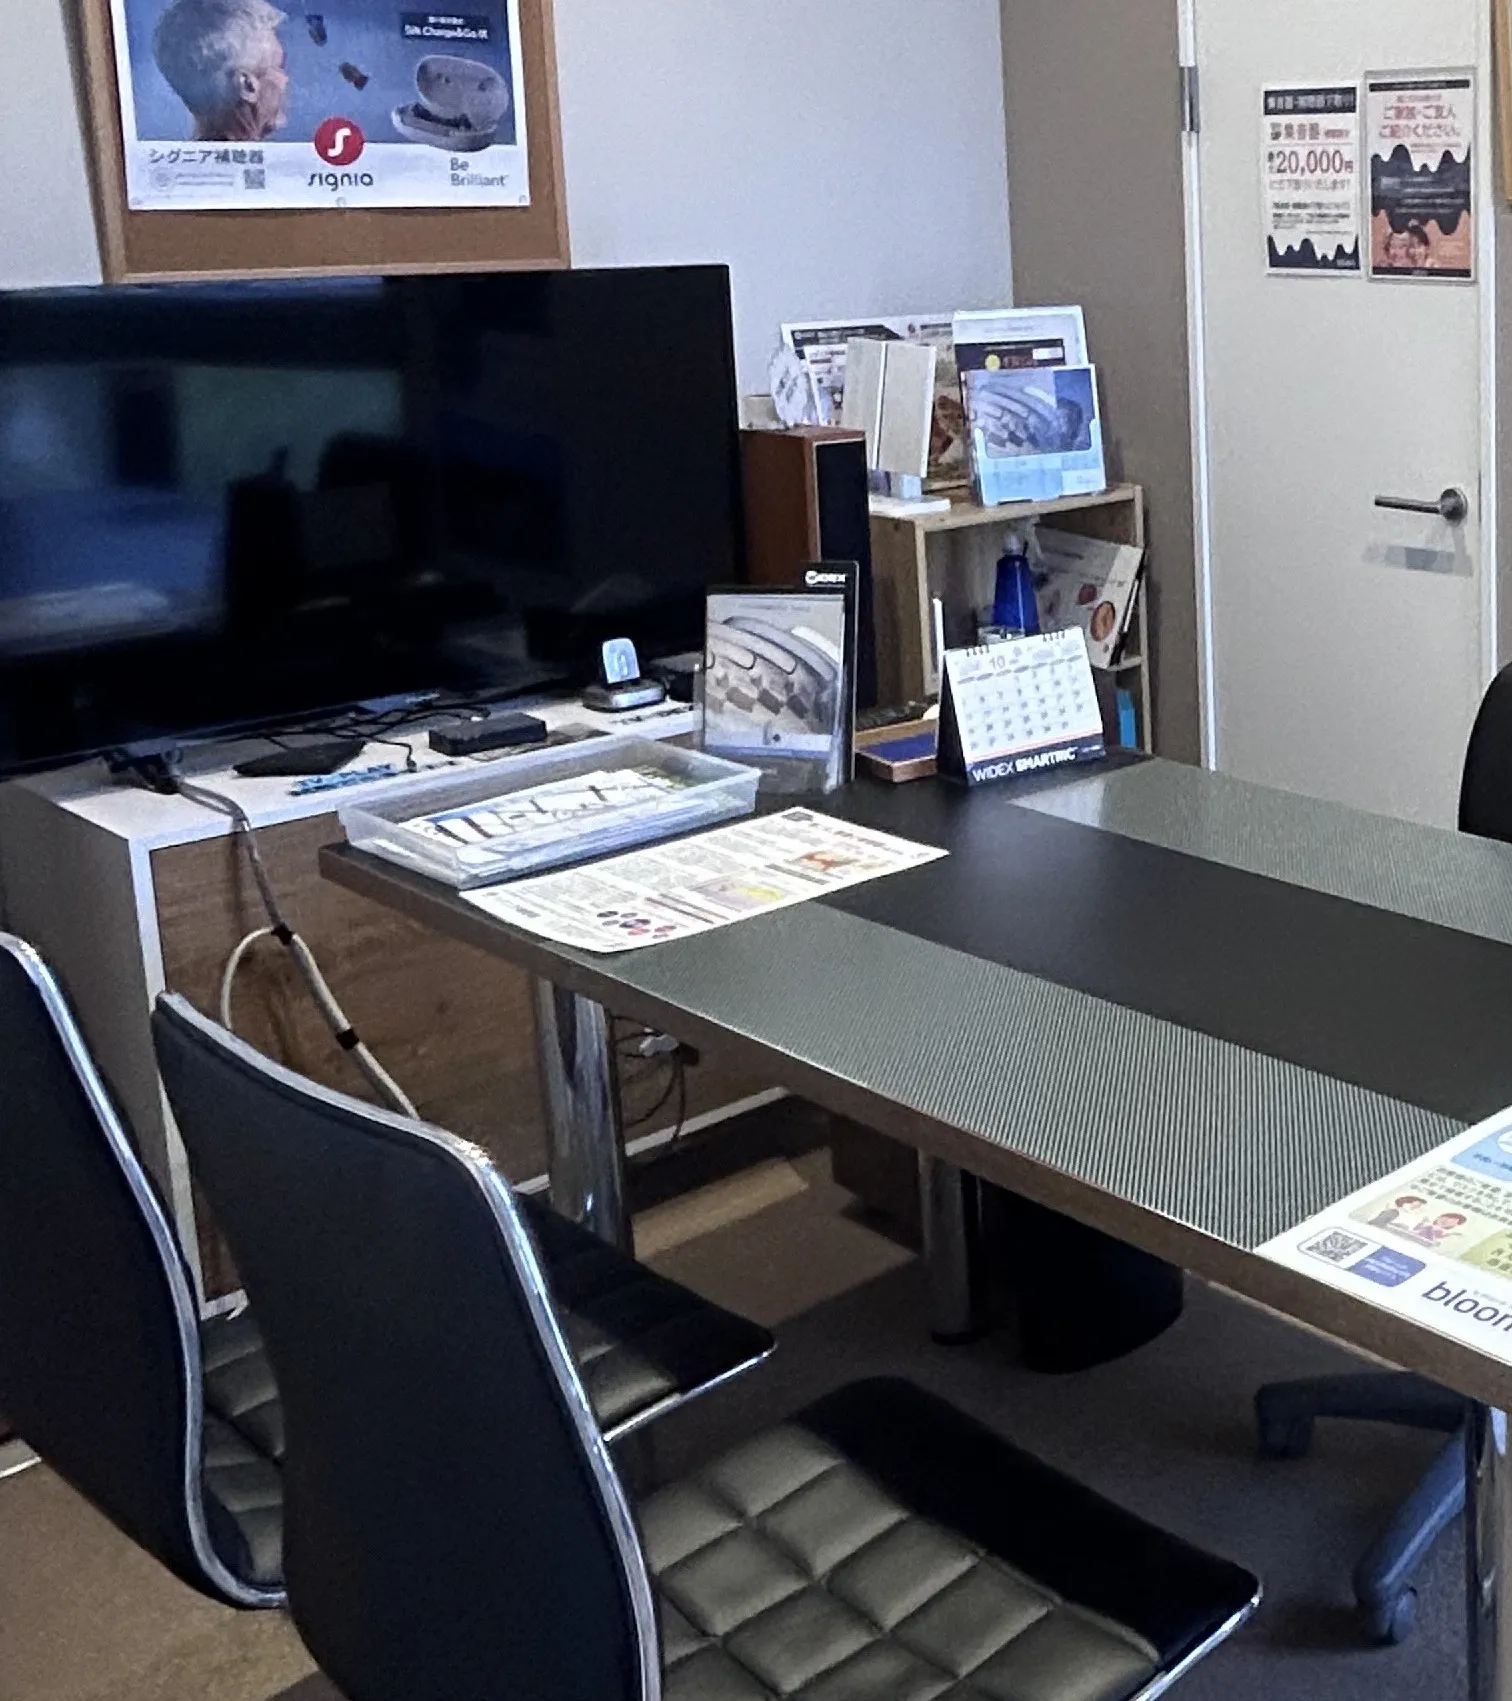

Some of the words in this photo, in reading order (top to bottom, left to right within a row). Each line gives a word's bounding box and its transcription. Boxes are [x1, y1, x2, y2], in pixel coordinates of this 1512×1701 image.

[149, 148, 264, 164] シグニア補聴器
[450, 157, 470, 171] Be
[307, 172, 374, 191] signia
[971, 761, 1014, 782] WIDEX
